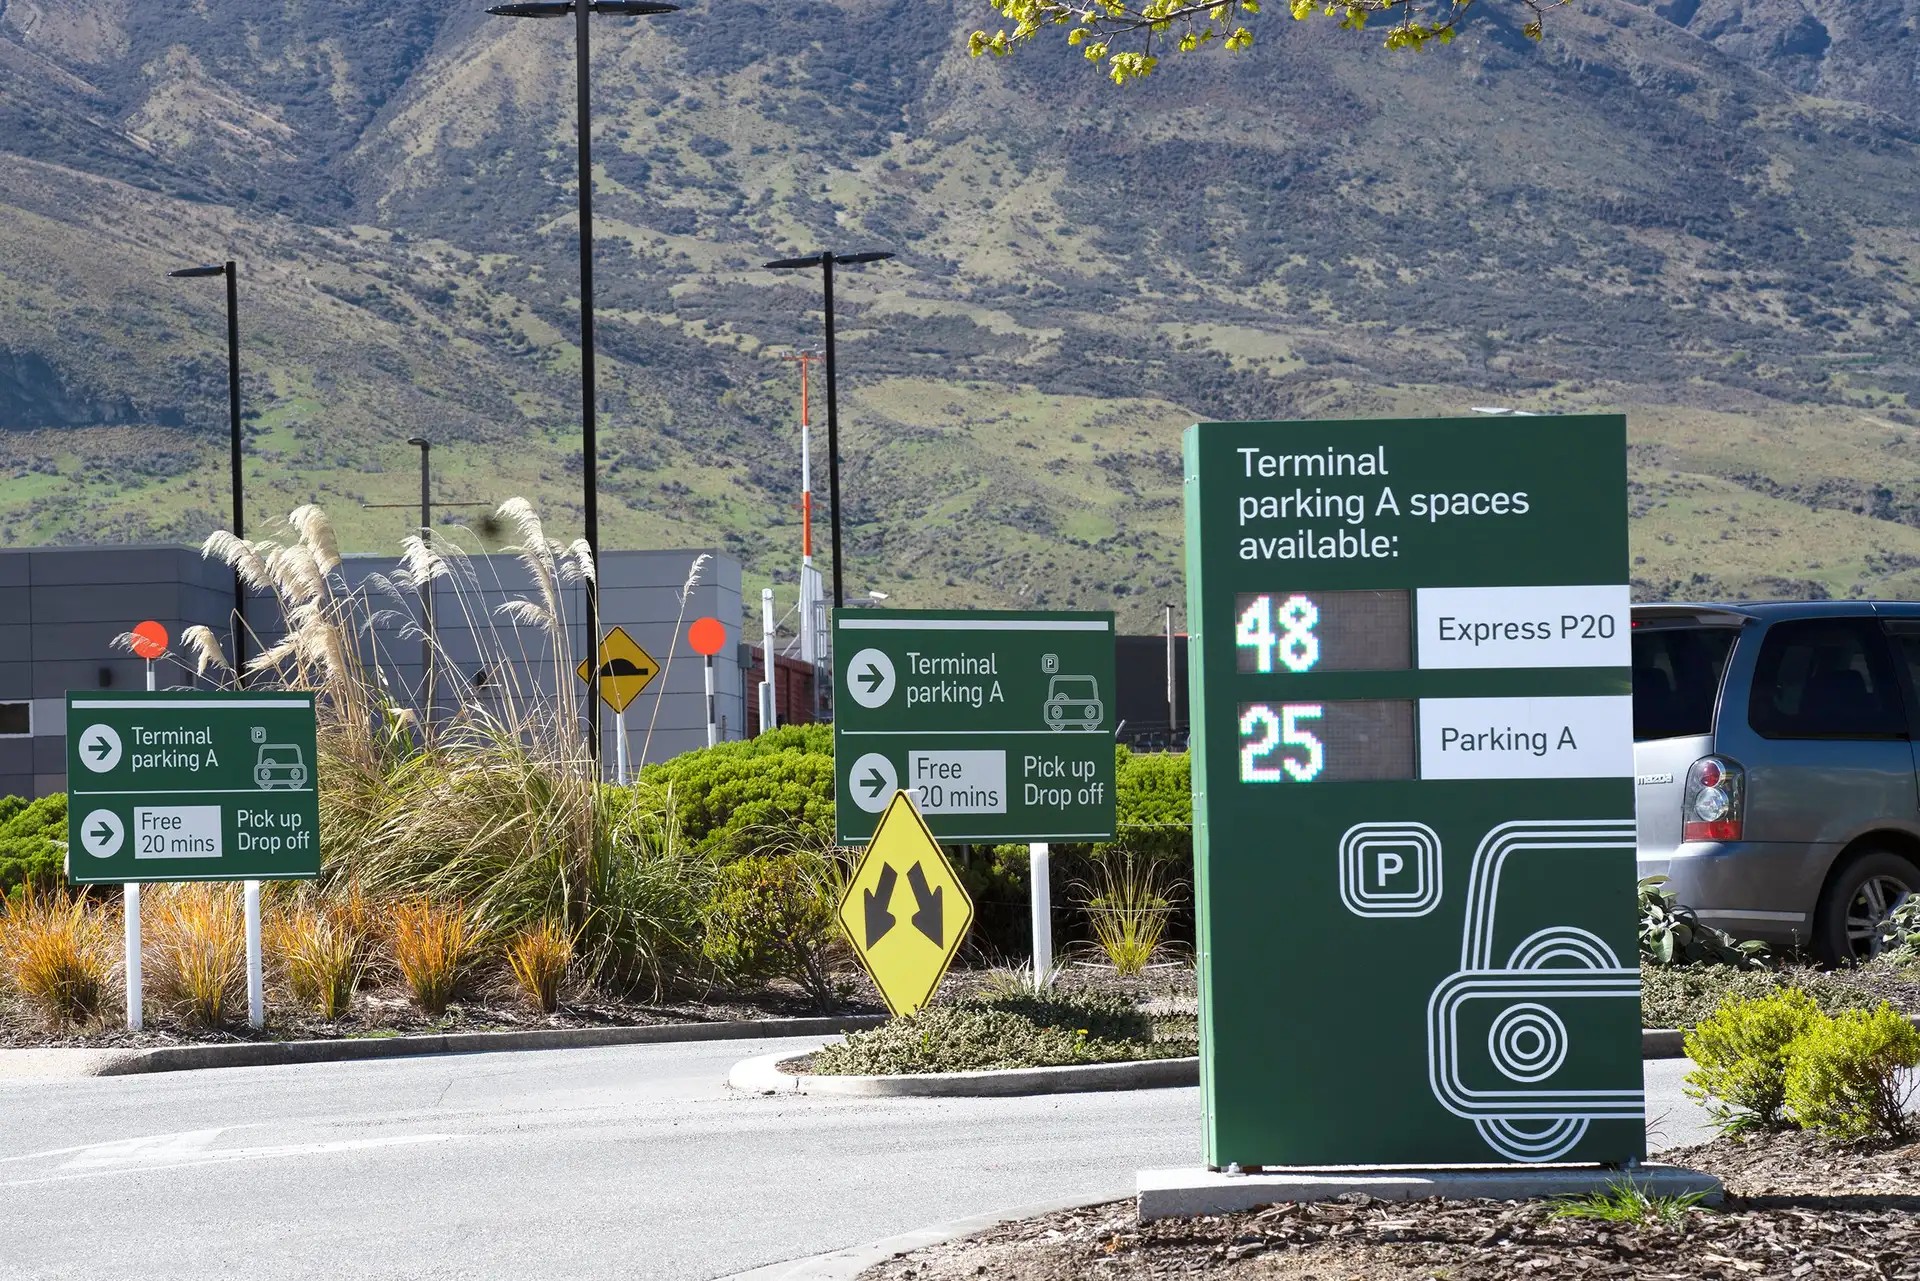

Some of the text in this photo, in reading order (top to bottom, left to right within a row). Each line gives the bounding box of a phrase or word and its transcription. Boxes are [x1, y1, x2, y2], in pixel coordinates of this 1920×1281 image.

[1237, 446, 1389, 478] Terminal
[1239, 487, 1530, 525] parking A spaces
[1239, 529, 1399, 560] available:
[1236, 594, 1320, 673] 48
[1438, 614, 1616, 646] Express P20
[906, 652, 998, 675] Terminal
[906, 681, 1005, 708] parking A
[131, 726, 213, 745] Terminal
[1239, 704, 1325, 783] 25
[1441, 726, 1578, 757] Parking A
[131, 749, 219, 772] parking A
[917, 757, 962, 779] Free
[1024, 755, 1096, 782] Pick up
[918, 785, 999, 807] 20 mins
[1024, 782, 1104, 810] Drop off
[141, 812, 182, 830] Free
[237, 809, 302, 831] Pick up
[142, 834, 215, 853] 20 mins
[238, 831, 310, 854] Drop off
[1377, 853, 1404, 887] P
